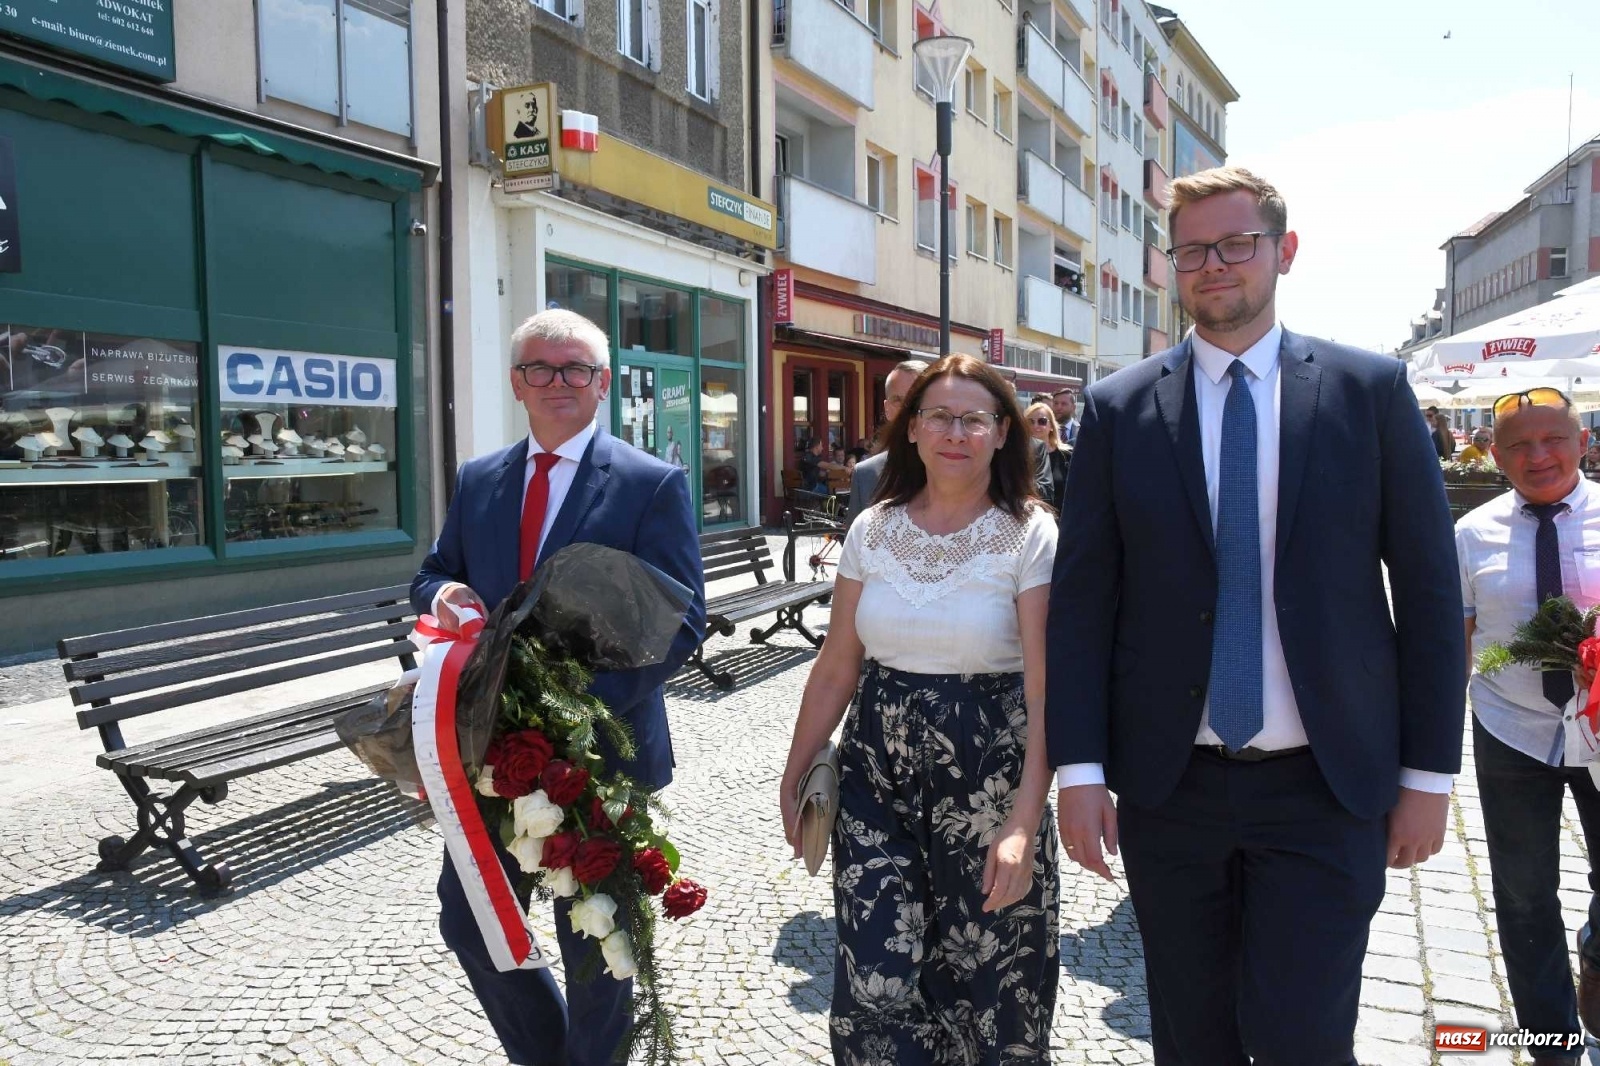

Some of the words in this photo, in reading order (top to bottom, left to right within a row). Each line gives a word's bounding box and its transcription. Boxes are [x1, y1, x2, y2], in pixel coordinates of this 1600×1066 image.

[96, 0, 154, 23] ADWOKAT
[98, 12, 111, 22] tel:
[111, 16, 125, 27] 602
[126, 21, 140, 32] 612
[141, 25, 154, 36] 648
[31, 16, 67, 34] e-mail:
[69, 26, 167, 67] biuro@zientek.com.pl
[520, 142, 547, 156] KASY
[508, 156, 549, 170] STEFCZYKA
[710, 191, 743, 216] STEFCZYK
[1489, 338, 1532, 354] ŻYWIEC
[91, 347, 144, 361] NAPRAWA
[147, 351, 198, 364] BIŻUTERII
[91, 372, 135, 384] SERWIS
[143, 374, 199, 387] ZEGARKÓW
[226, 352, 382, 401] CASIO
[662, 384, 686, 400] GRAMY
